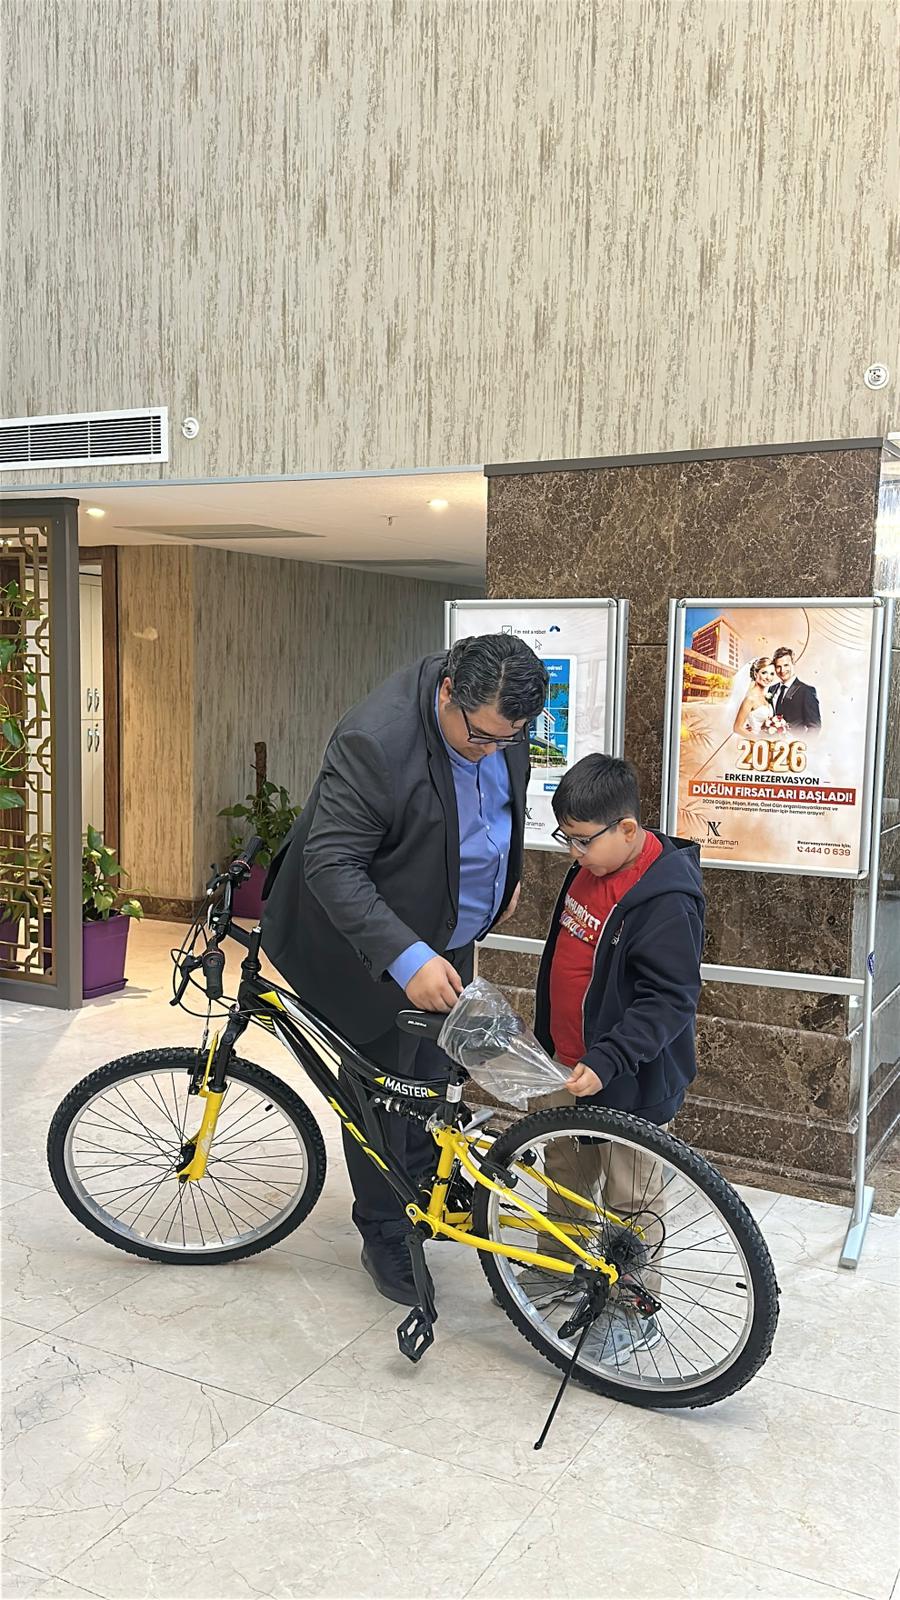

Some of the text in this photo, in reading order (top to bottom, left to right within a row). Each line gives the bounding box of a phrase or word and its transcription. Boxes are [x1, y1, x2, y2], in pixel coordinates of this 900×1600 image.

[736, 739, 807, 773] 2026
[724, 773, 820, 785] ERKEN REZERVASYON
[692, 783, 853, 803] DÜĞÜN FIRSATLARI BAŞLADI!
[708, 837, 739, 846] Karaman
[823, 847, 831, 855] 0
[832, 848, 851, 856] 639
[384, 1077, 429, 1098] MASTER
